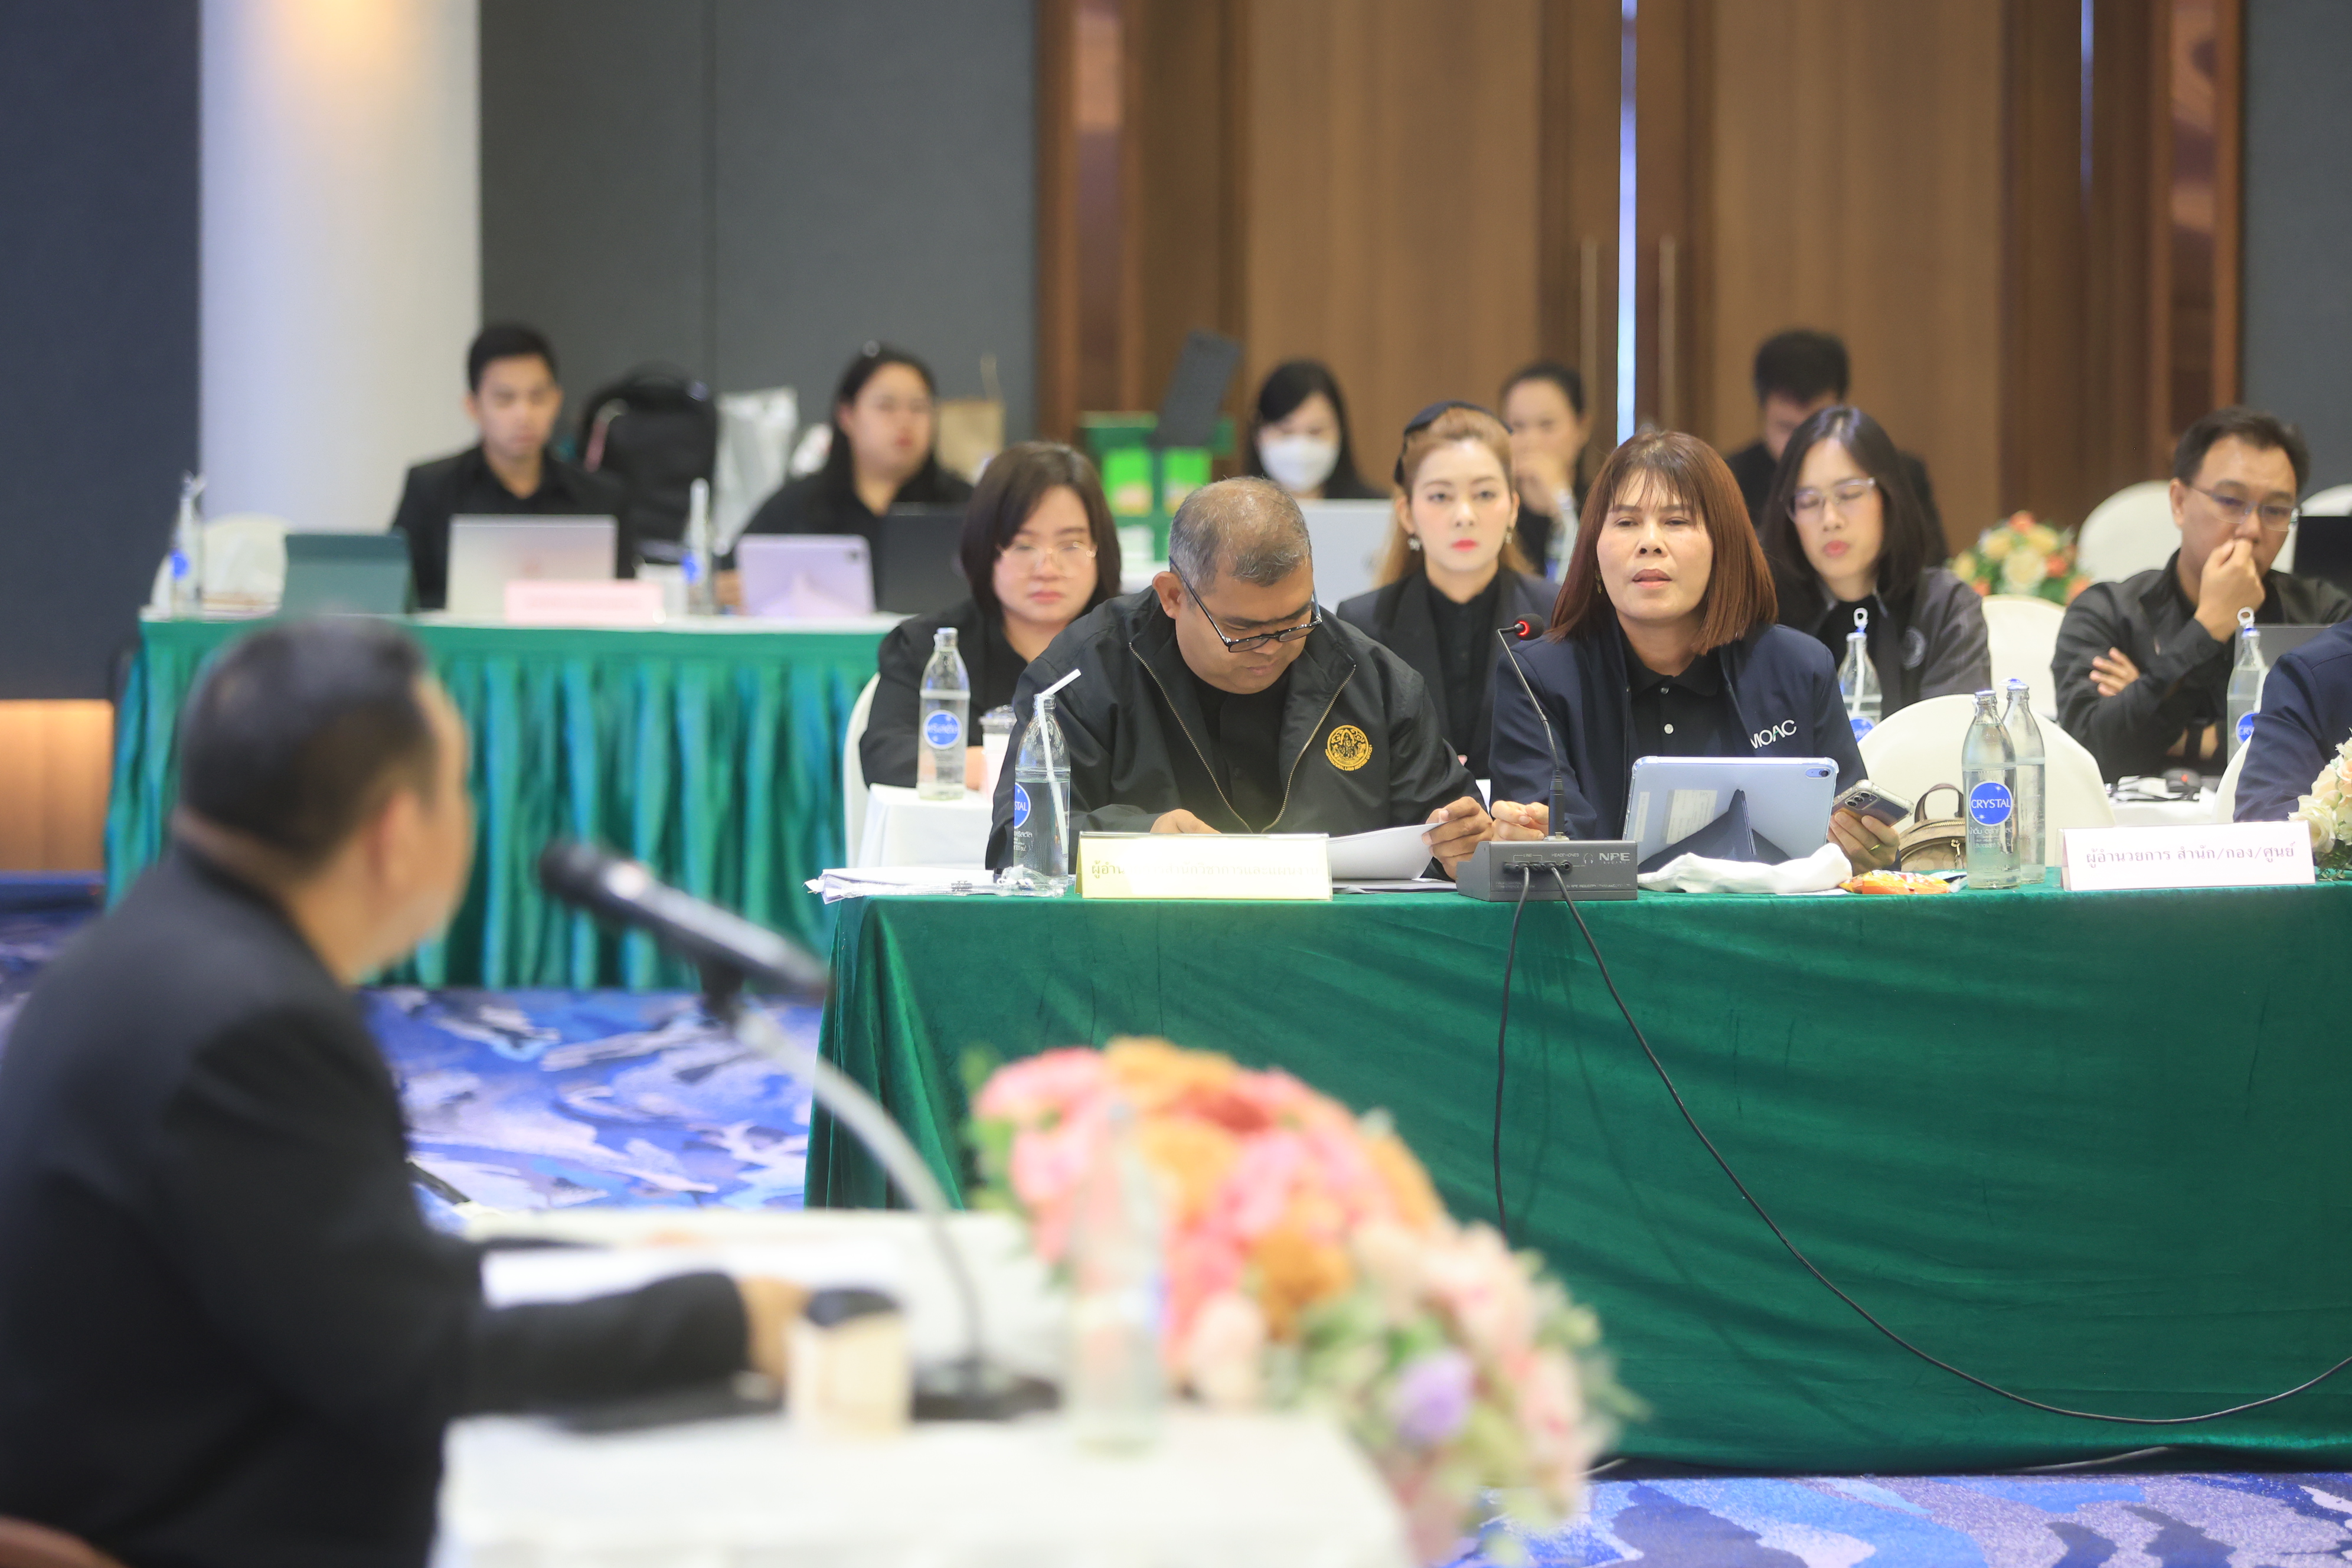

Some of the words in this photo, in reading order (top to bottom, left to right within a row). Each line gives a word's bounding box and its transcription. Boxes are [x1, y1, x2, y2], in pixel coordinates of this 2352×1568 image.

[1014, 801, 1027, 811] STAL
[1971, 798, 2010, 808] CRYSTAL
[1599, 852, 1631, 861] NPE
[2086, 847, 2170, 868] ผู้อำนวยการ
[2177, 841, 2296, 863] สำนัก/กอง/ศูนย์
